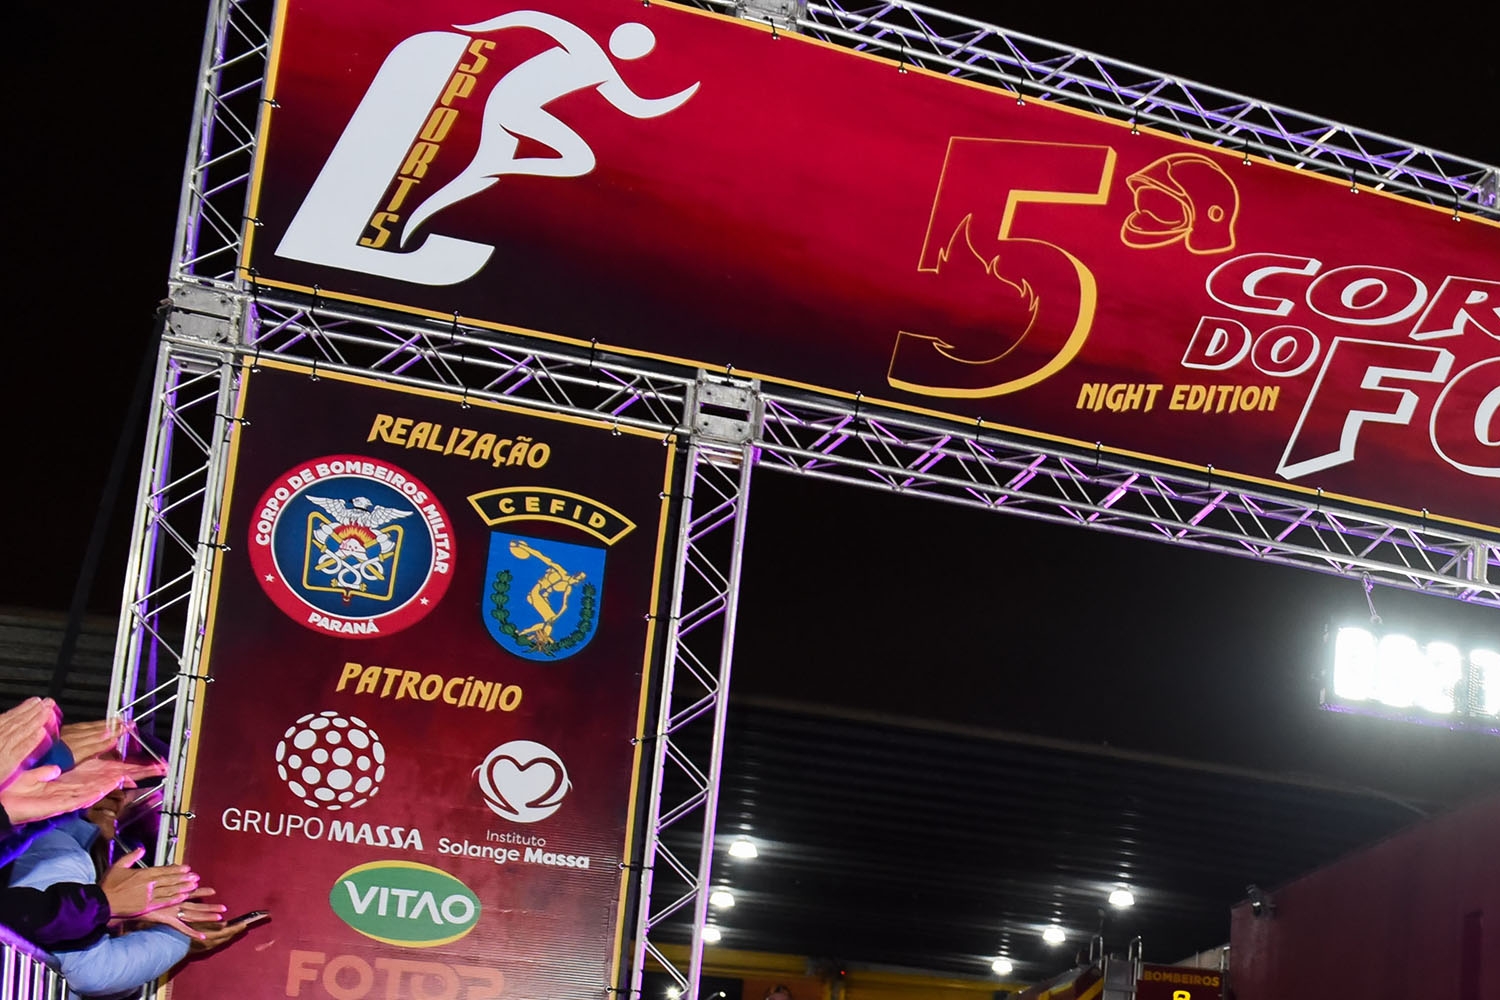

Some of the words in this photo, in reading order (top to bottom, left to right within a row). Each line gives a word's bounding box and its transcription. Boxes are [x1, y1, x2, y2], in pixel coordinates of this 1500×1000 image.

[357, 39, 496, 249] SPORTS
[1181, 316, 1321, 376] DO
[1076, 382, 1162, 413] NIGHT
[1169, 383, 1280, 414] EDITION
[366, 413, 551, 469] REALIZAÇÃO
[256, 487, 290, 546] CORPO
[288, 468, 315, 490] DE
[316, 461, 428, 506] BOMBEIROS
[423, 504, 450, 575] MILITAR
[498, 496, 608, 531] CEFID
[307, 611, 380, 635] PARANÁ
[336, 662, 523, 712] PATROCÍNIO
[221, 807, 324, 840] GRUPO
[327, 820, 424, 851] MASSA
[486, 829, 546, 847] Instituto
[438, 838, 520, 865] Solange
[523, 848, 590, 869] Massa
[343, 880, 475, 926] VITAO
[1144, 970, 1220, 988] BOMBEIROS
